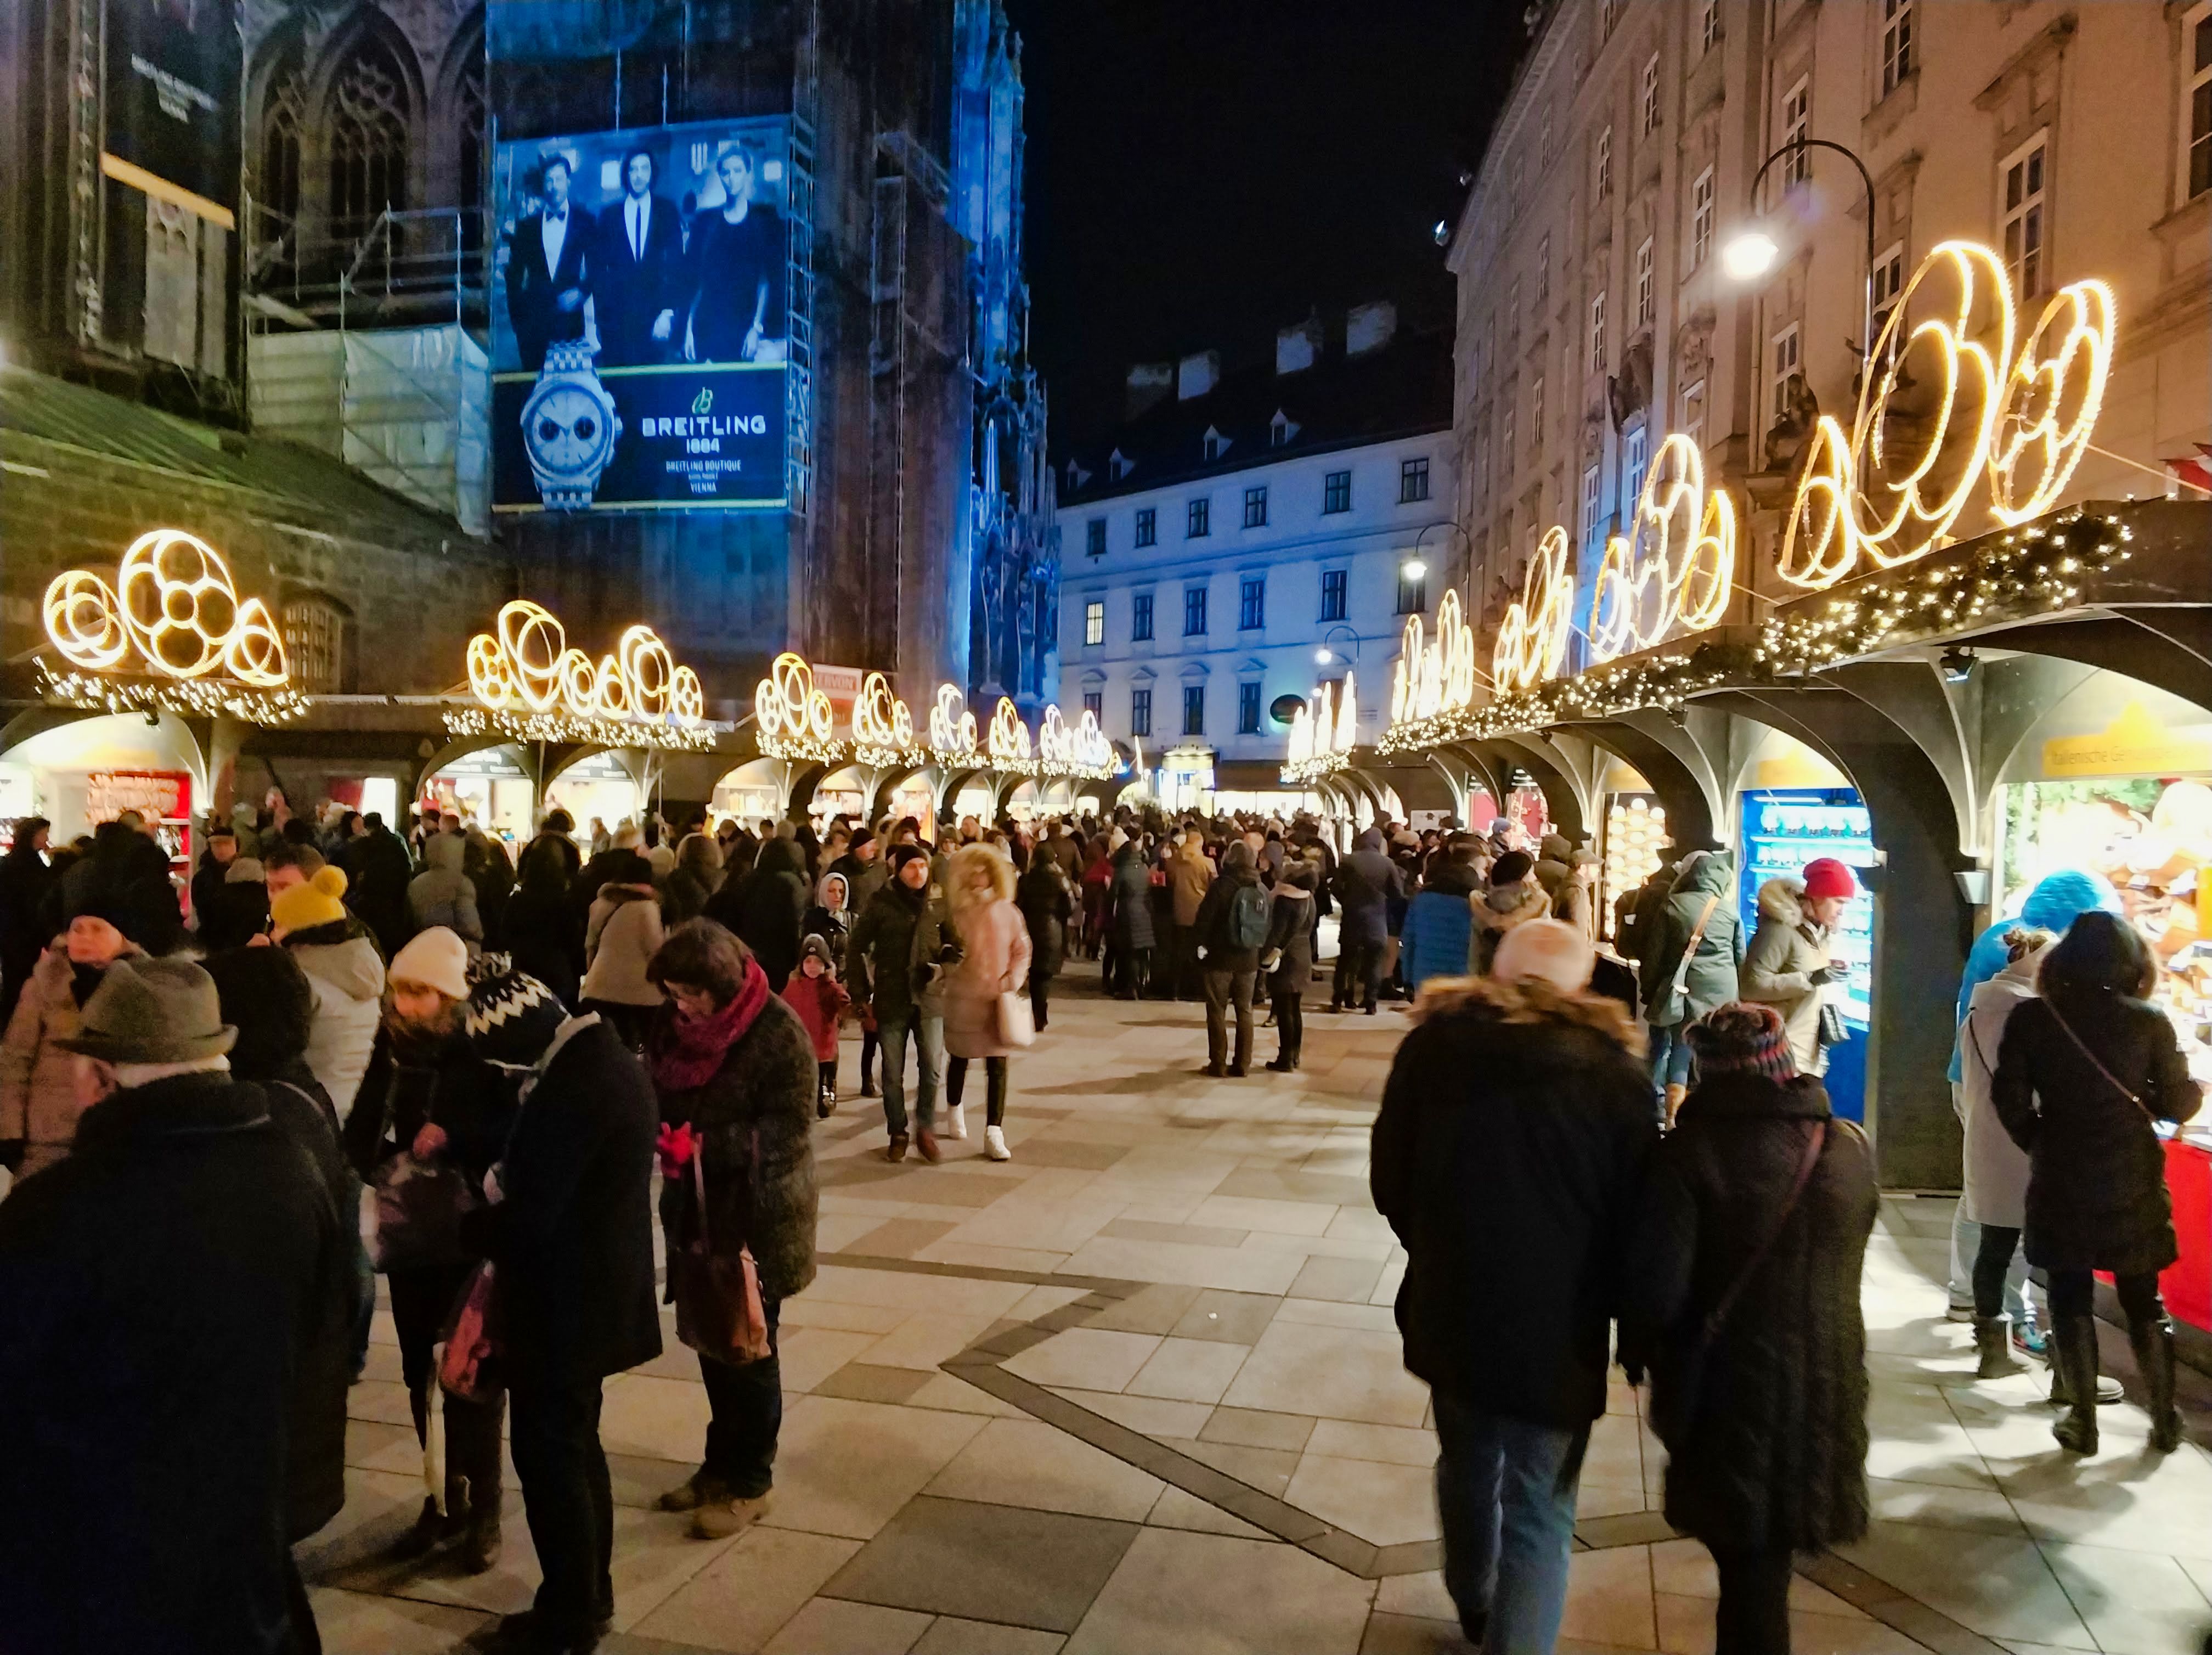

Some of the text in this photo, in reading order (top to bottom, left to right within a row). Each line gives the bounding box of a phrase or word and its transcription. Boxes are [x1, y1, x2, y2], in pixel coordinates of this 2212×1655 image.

[642, 415, 766, 437] BREITLING
[666, 460, 741, 472] BREITLING BOUTIQUE
[691, 482, 716, 493] VIENNA
